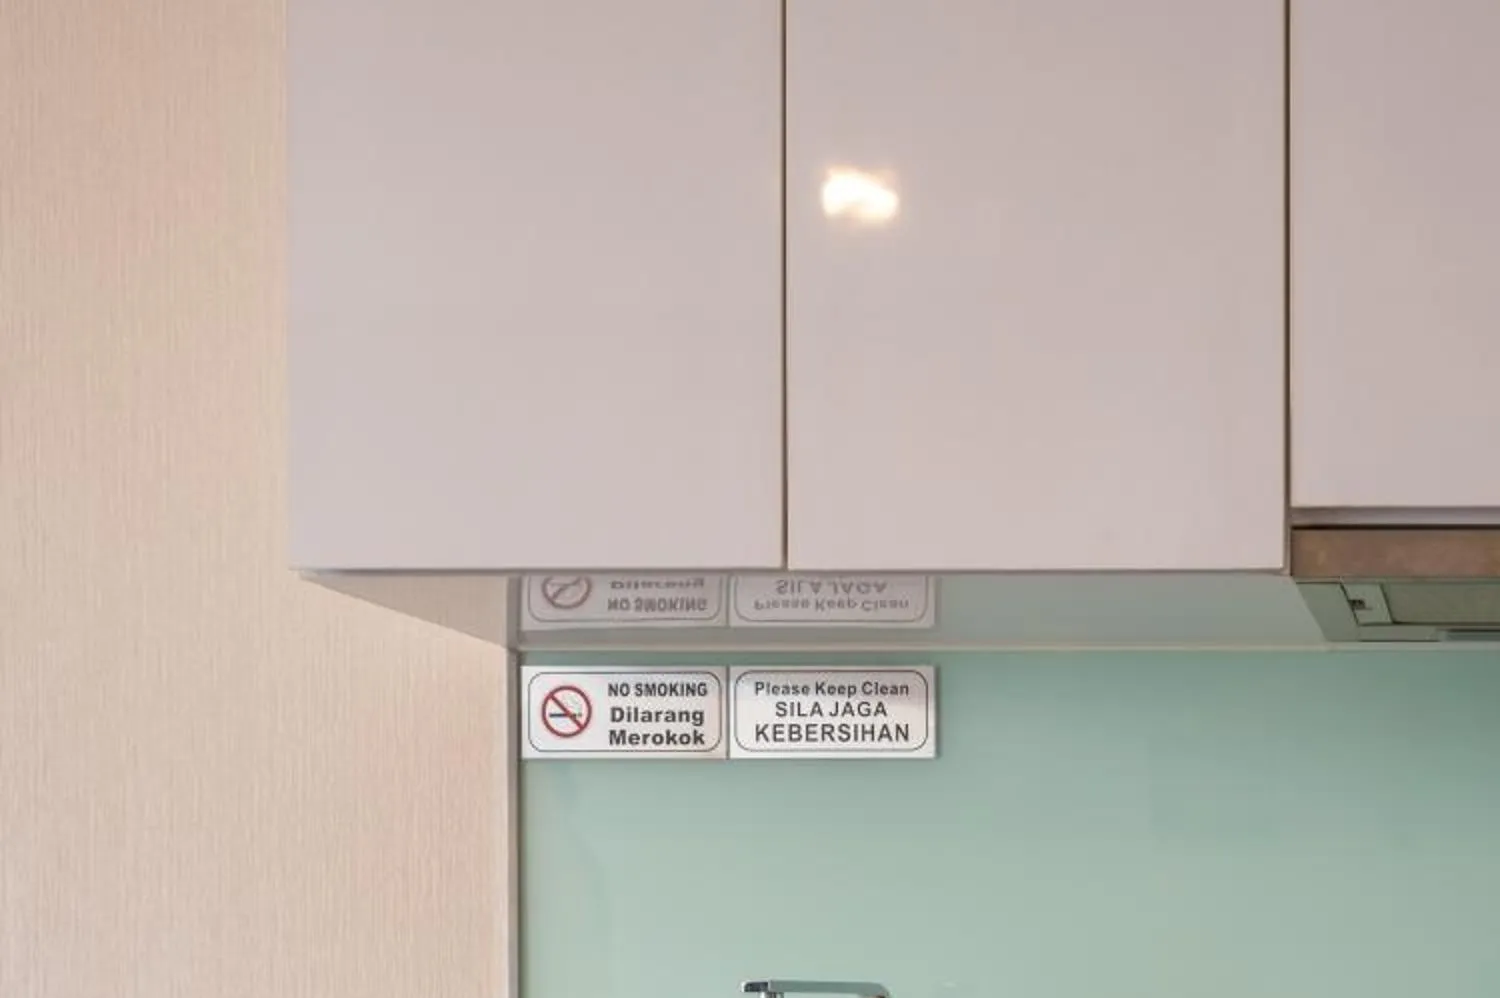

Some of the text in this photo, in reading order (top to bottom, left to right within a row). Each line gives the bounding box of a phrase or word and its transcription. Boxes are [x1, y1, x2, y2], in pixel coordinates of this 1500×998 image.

[608, 682, 708, 697] NO SMOKING
[754, 681, 910, 698] Please Keep Clean
[610, 706, 705, 726] Dilarang
[775, 701, 888, 717] SILA JAGA
[609, 729, 705, 746] Merokok
[755, 723, 910, 743] KEBERSIHAN
